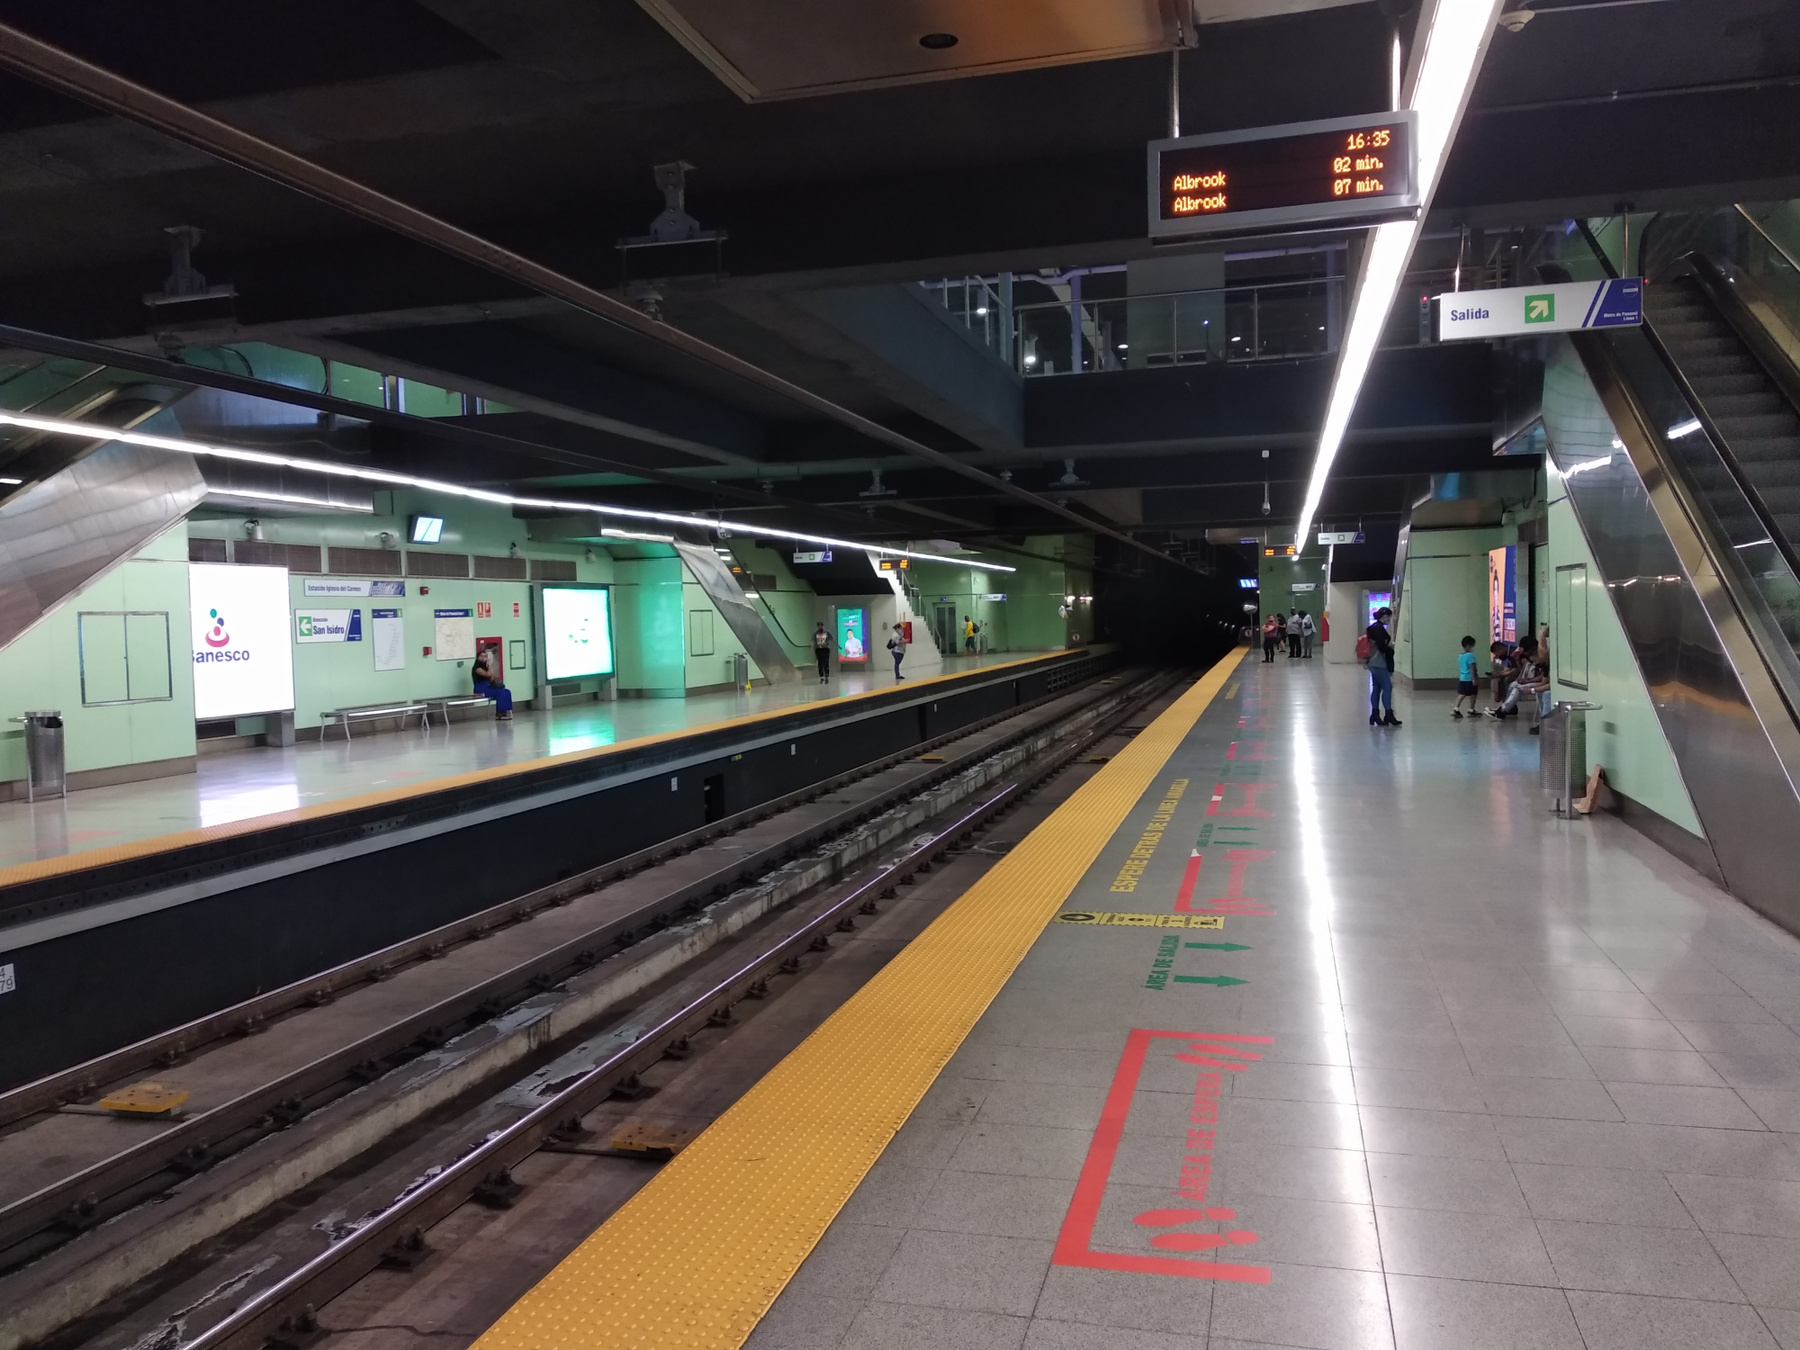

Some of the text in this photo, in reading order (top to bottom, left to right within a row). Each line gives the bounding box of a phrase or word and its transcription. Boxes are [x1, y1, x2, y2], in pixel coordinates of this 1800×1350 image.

[1346, 129, 1391, 151] 16:35
[1333, 153, 1384, 173] 02 min.
[1173, 170, 1227, 191] Albrook
[1333, 175, 1384, 196] 07 min.
[1173, 192, 1227, 212] Albrook
[1450, 307, 1490, 322] Salida
[313, 624, 345, 635] San Isidro
[192, 649, 250, 663] anesco
[1109, 859, 1149, 893] ESPERE
[1153, 958, 1174, 969] DE
[1190, 1072, 1223, 1124] ESPERA
[1185, 1128, 1217, 1150] DE
